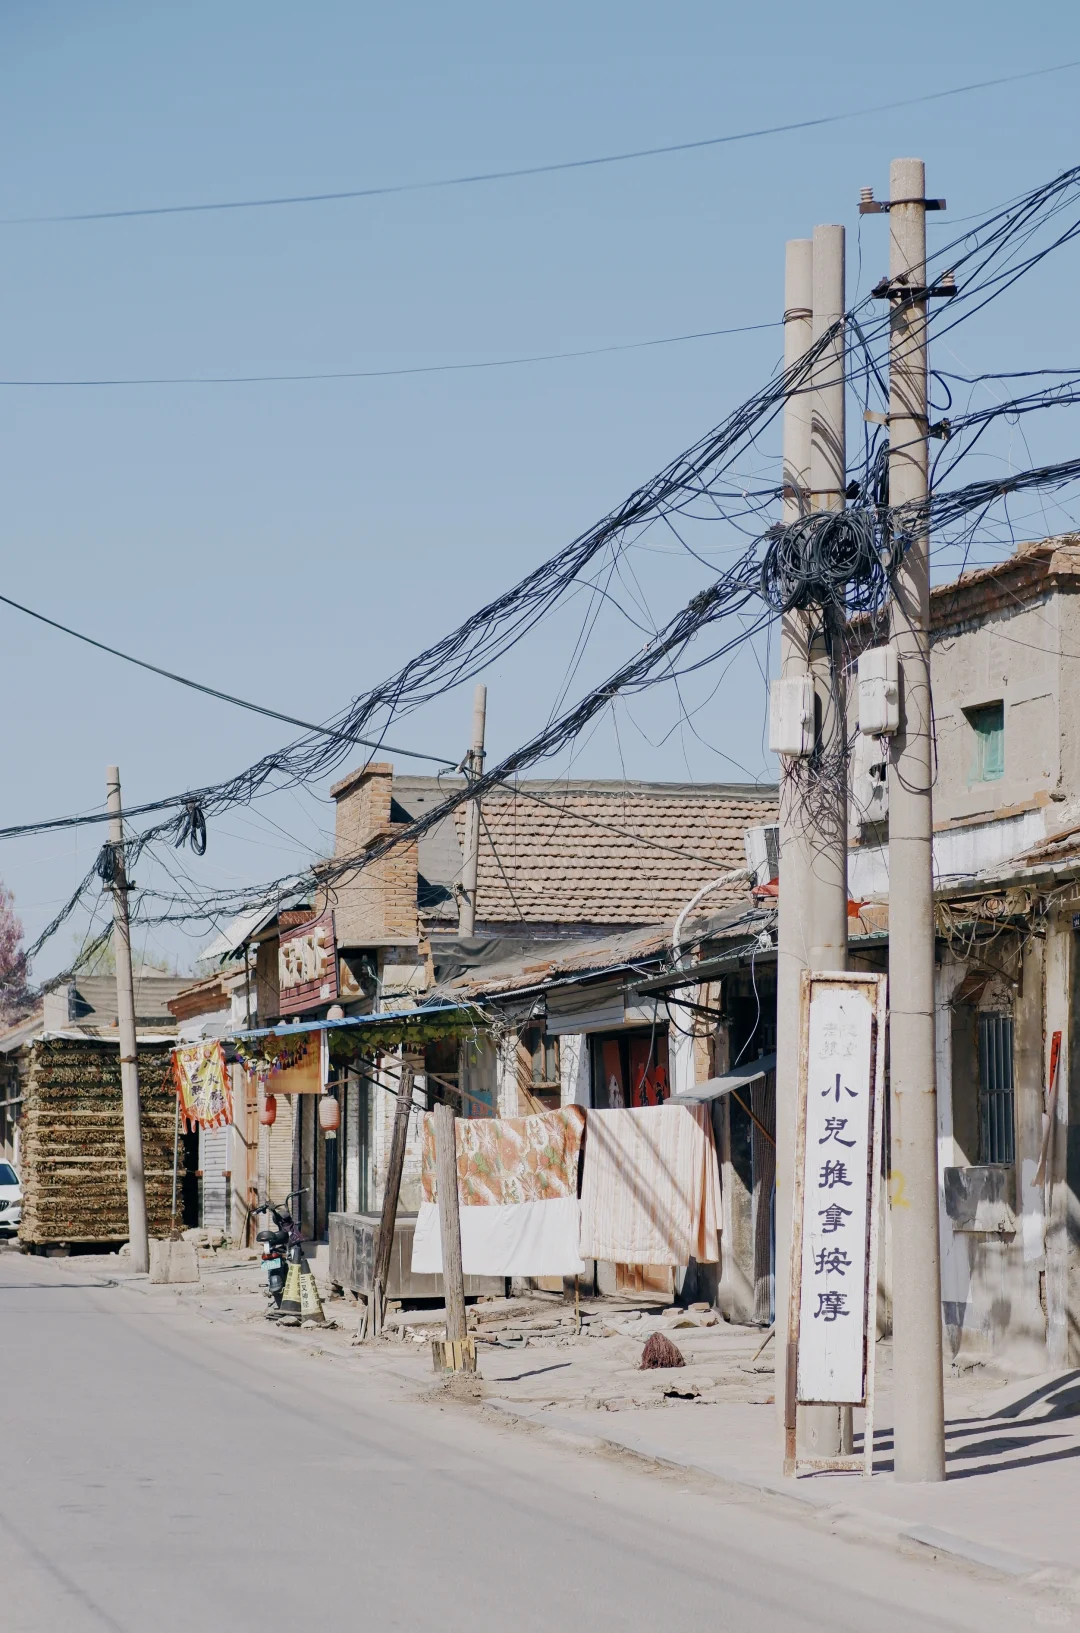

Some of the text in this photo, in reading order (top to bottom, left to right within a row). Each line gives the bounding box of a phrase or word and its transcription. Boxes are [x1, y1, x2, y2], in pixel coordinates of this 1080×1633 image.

[814, 1073, 859, 1322] 小兒推拿按摩
